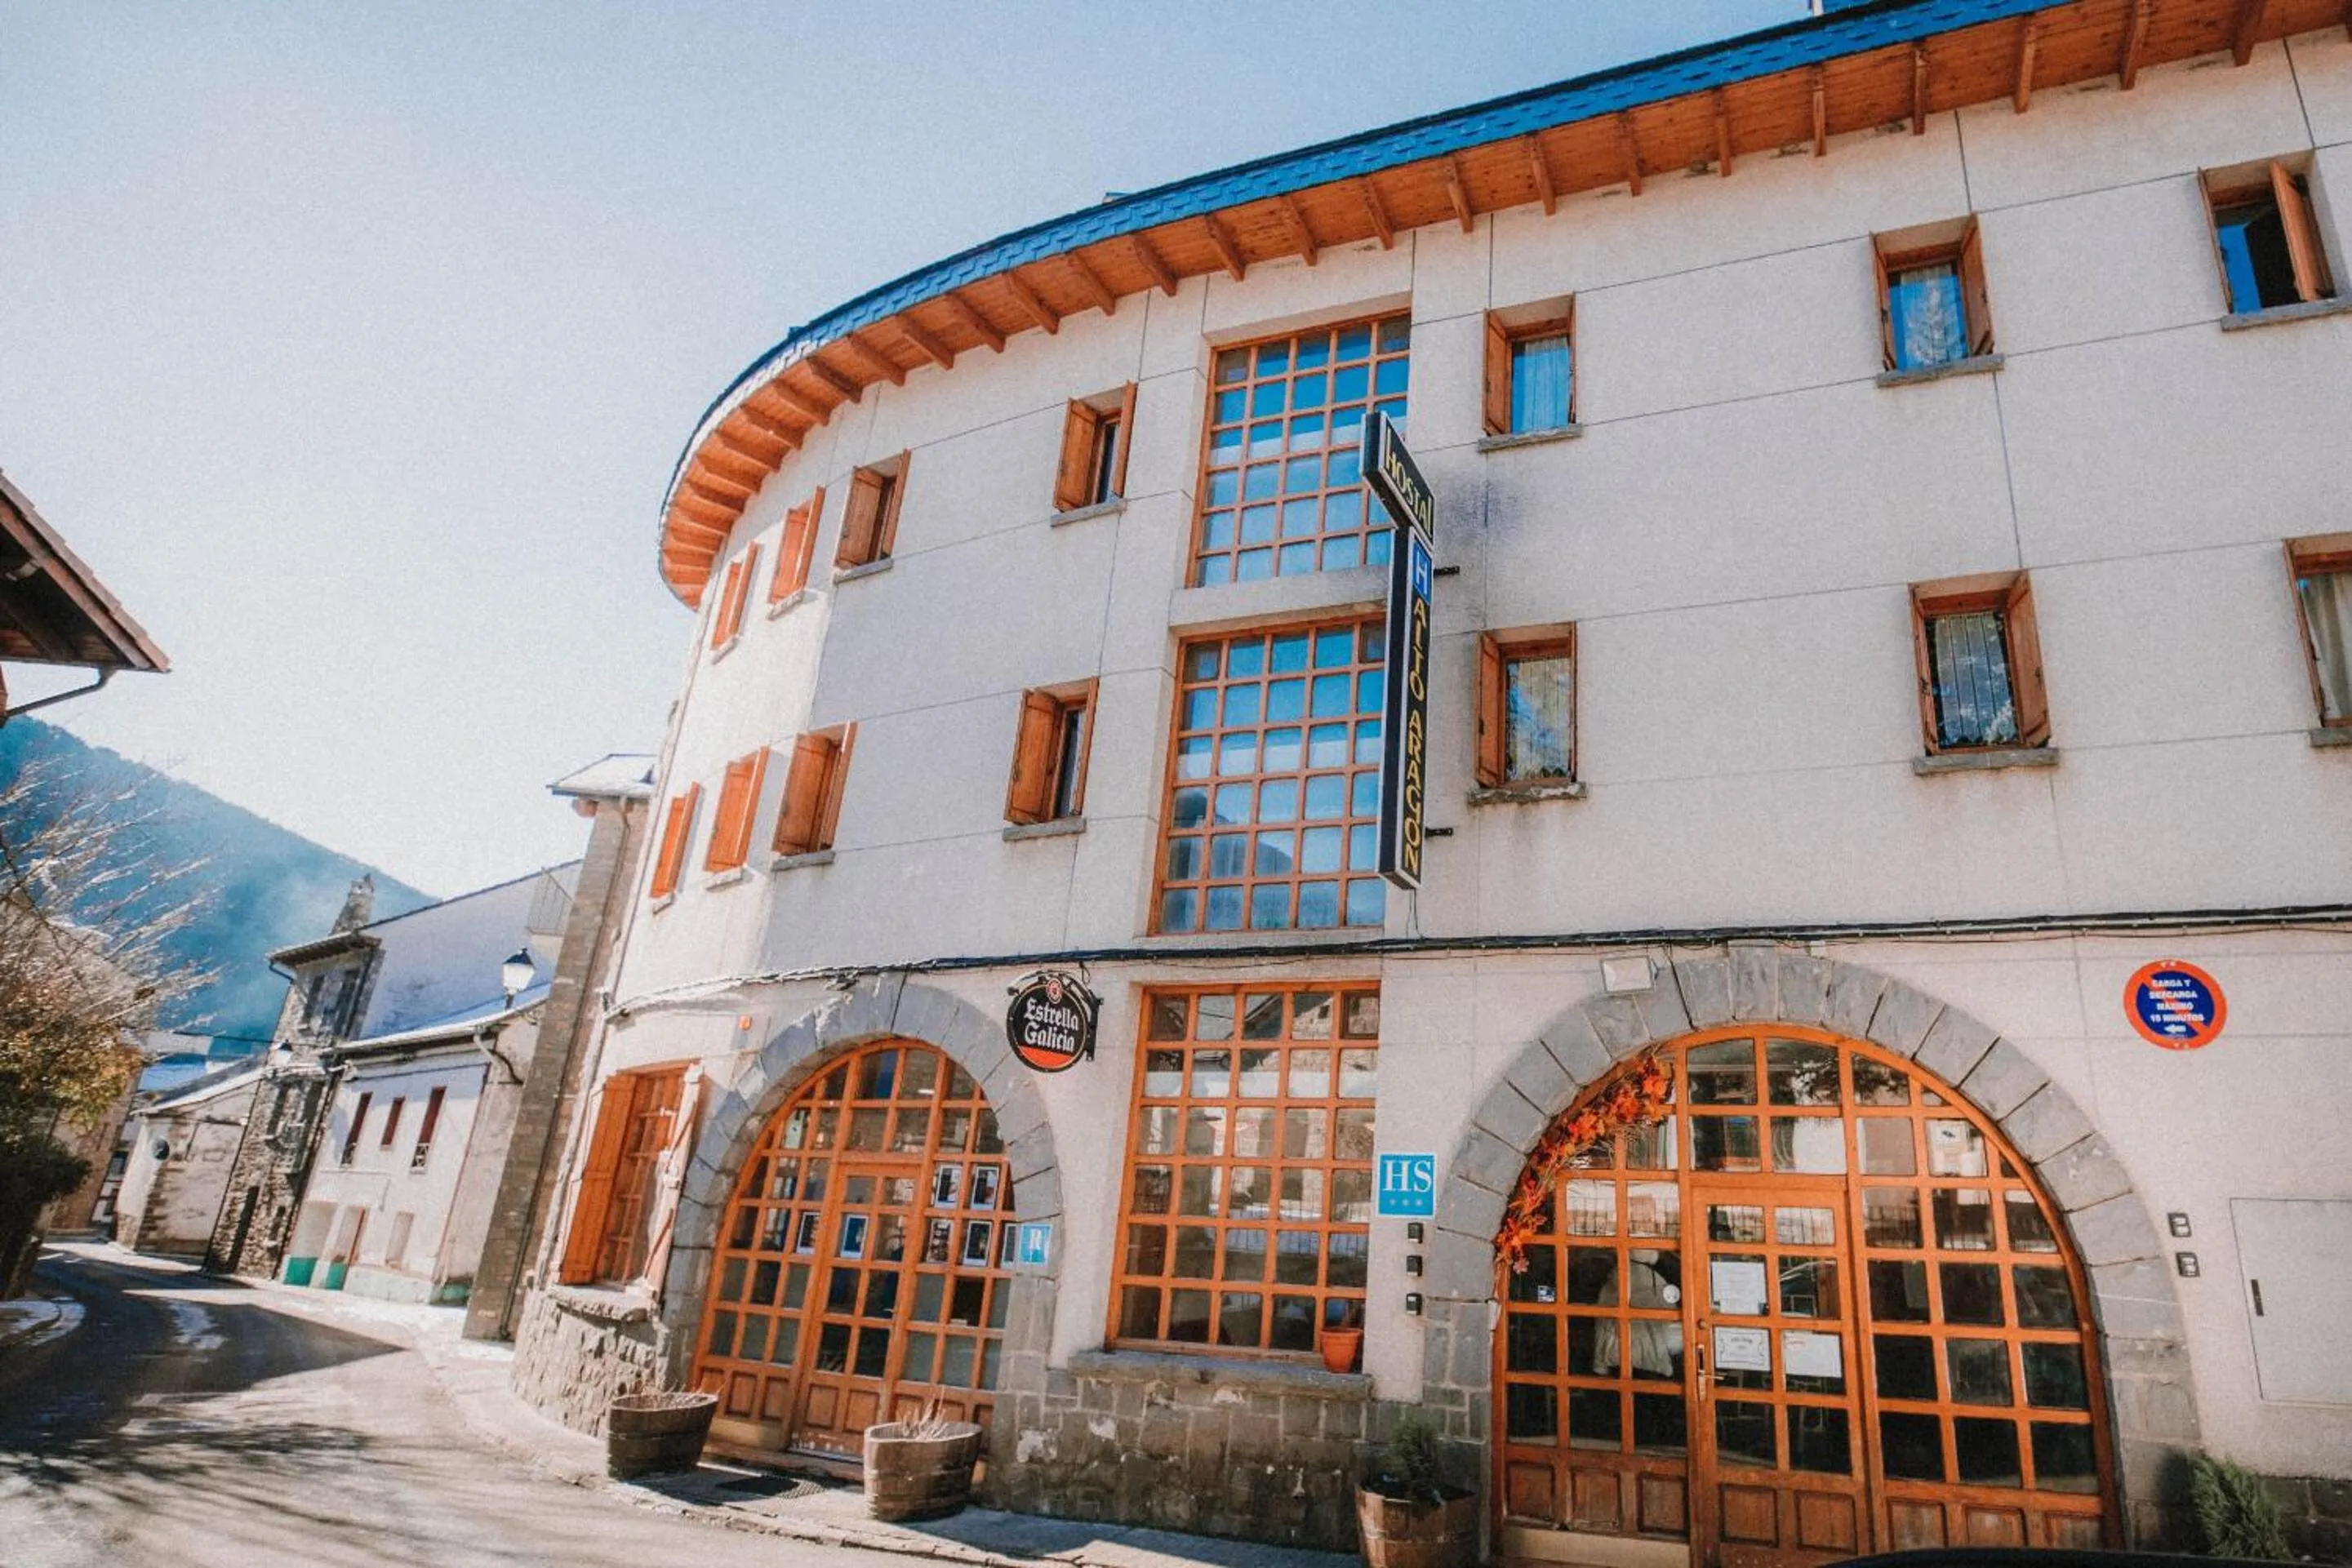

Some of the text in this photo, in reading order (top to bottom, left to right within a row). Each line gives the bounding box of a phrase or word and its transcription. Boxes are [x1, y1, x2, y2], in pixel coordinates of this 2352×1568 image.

[1385, 425, 1434, 540] HOSTAL
[1416, 549, 1428, 596] H
[1408, 597, 1428, 703] ALTO
[2149, 990, 2198, 999] DESCARGA
[2184, 979, 2191, 987] Y
[1023, 997, 1079, 1032] Estrella
[2163, 1014, 2203, 1022] MINUTOS
[1025, 1020, 1075, 1053] Galicia
[1381, 1159, 1433, 1193] HS
